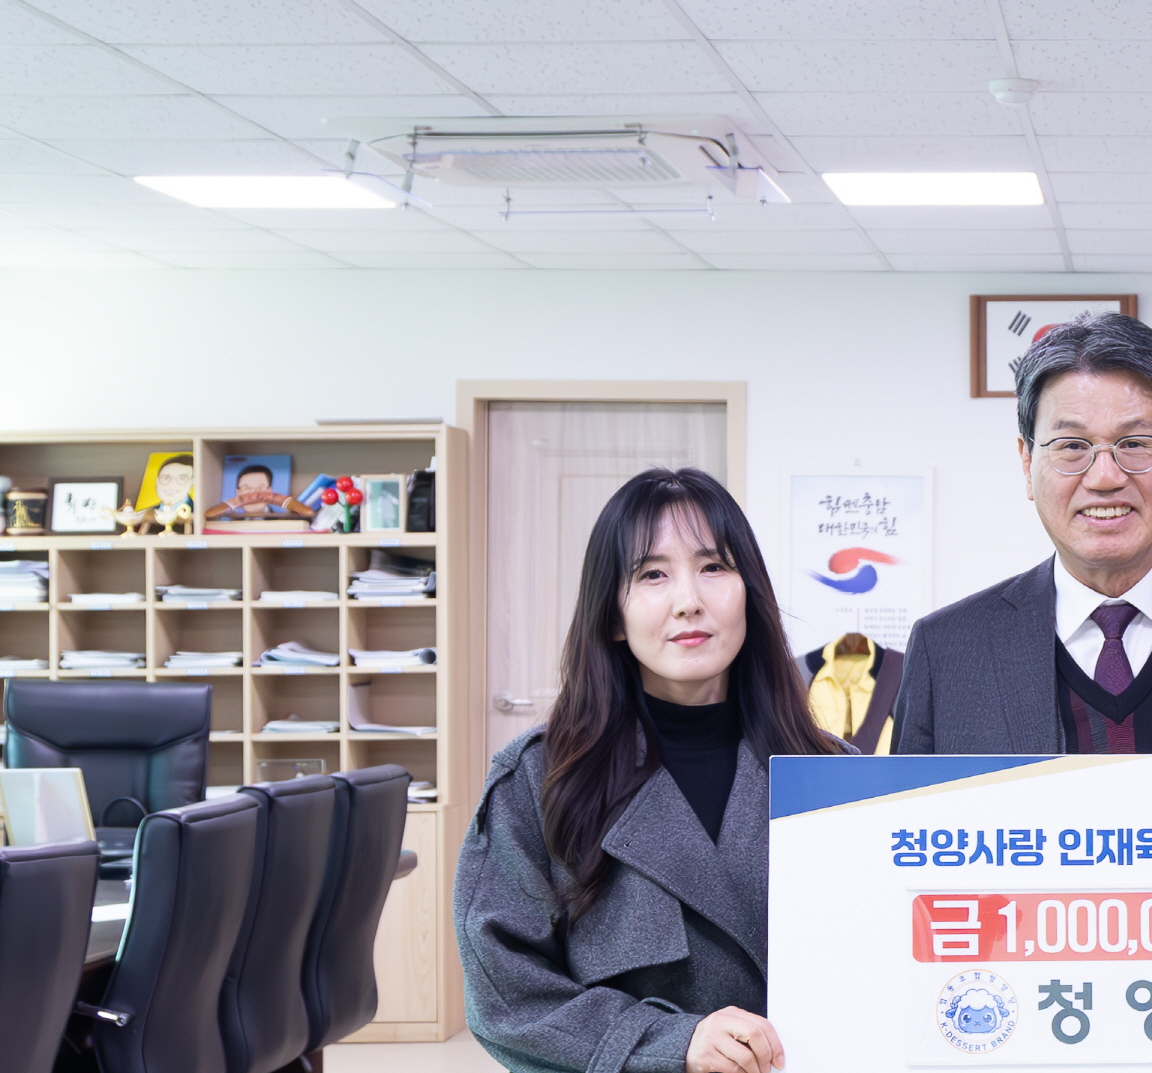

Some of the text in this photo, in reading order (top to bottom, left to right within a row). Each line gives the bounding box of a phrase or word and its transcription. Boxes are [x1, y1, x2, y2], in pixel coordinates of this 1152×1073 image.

[891, 828, 1046, 867] 청양사랑
[930, 900, 982, 956] 금
[940, 1020, 1015, 1052] K-DESSERT BRAND
